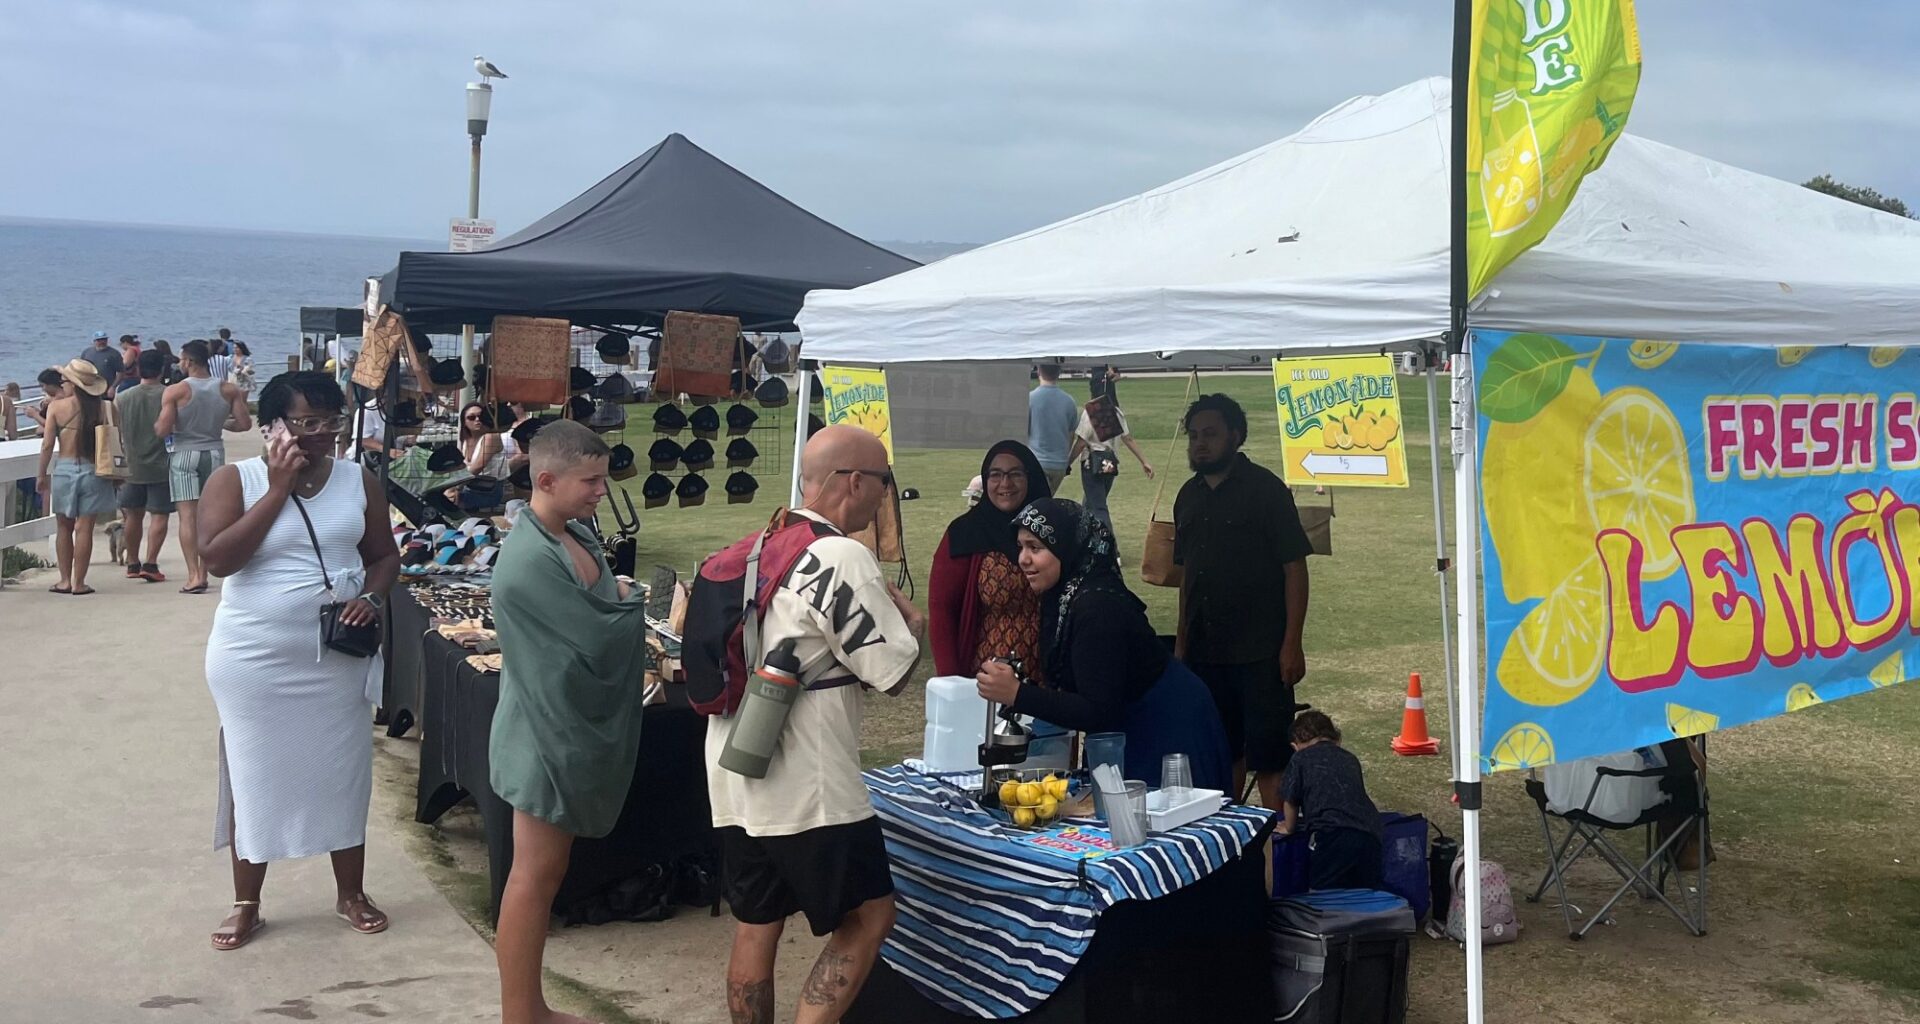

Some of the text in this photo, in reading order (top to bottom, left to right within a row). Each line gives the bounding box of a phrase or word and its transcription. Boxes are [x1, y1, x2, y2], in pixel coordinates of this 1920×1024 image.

[452, 226, 494, 235] REGULATIONS
[1277, 373, 1394, 439] LEMONADE
[1706, 396, 1920, 473] FRESH S
